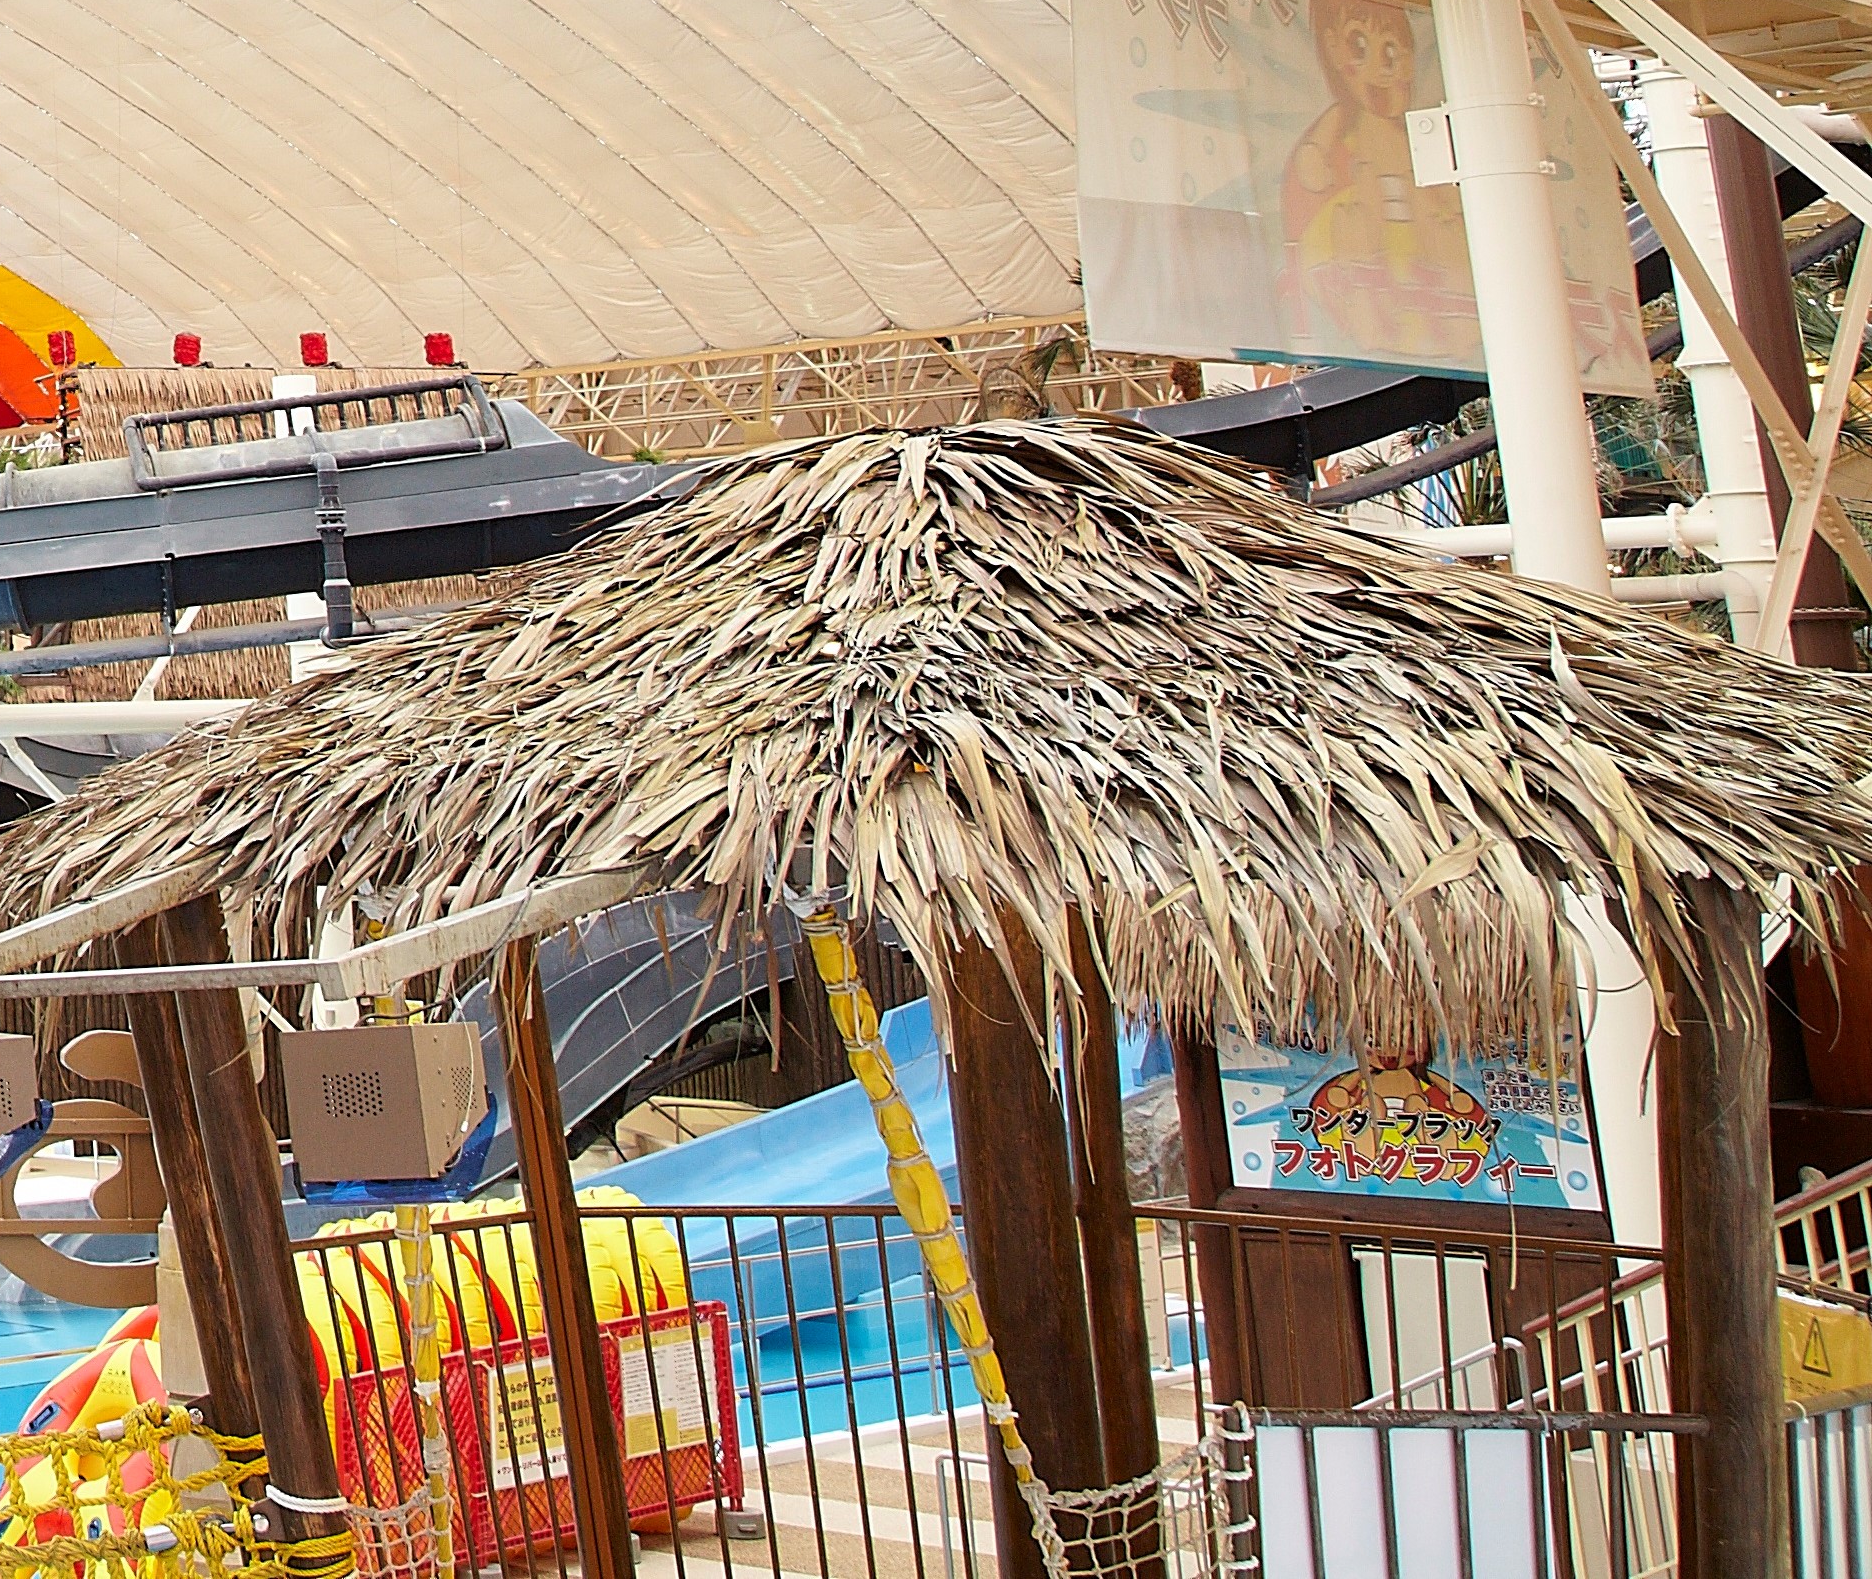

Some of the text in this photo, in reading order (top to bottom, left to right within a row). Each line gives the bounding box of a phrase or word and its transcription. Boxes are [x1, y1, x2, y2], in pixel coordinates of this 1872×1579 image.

[1288, 1106, 1503, 1148] ワンダーブラック
[1271, 1139, 1556, 1193] フォトグラフィー
